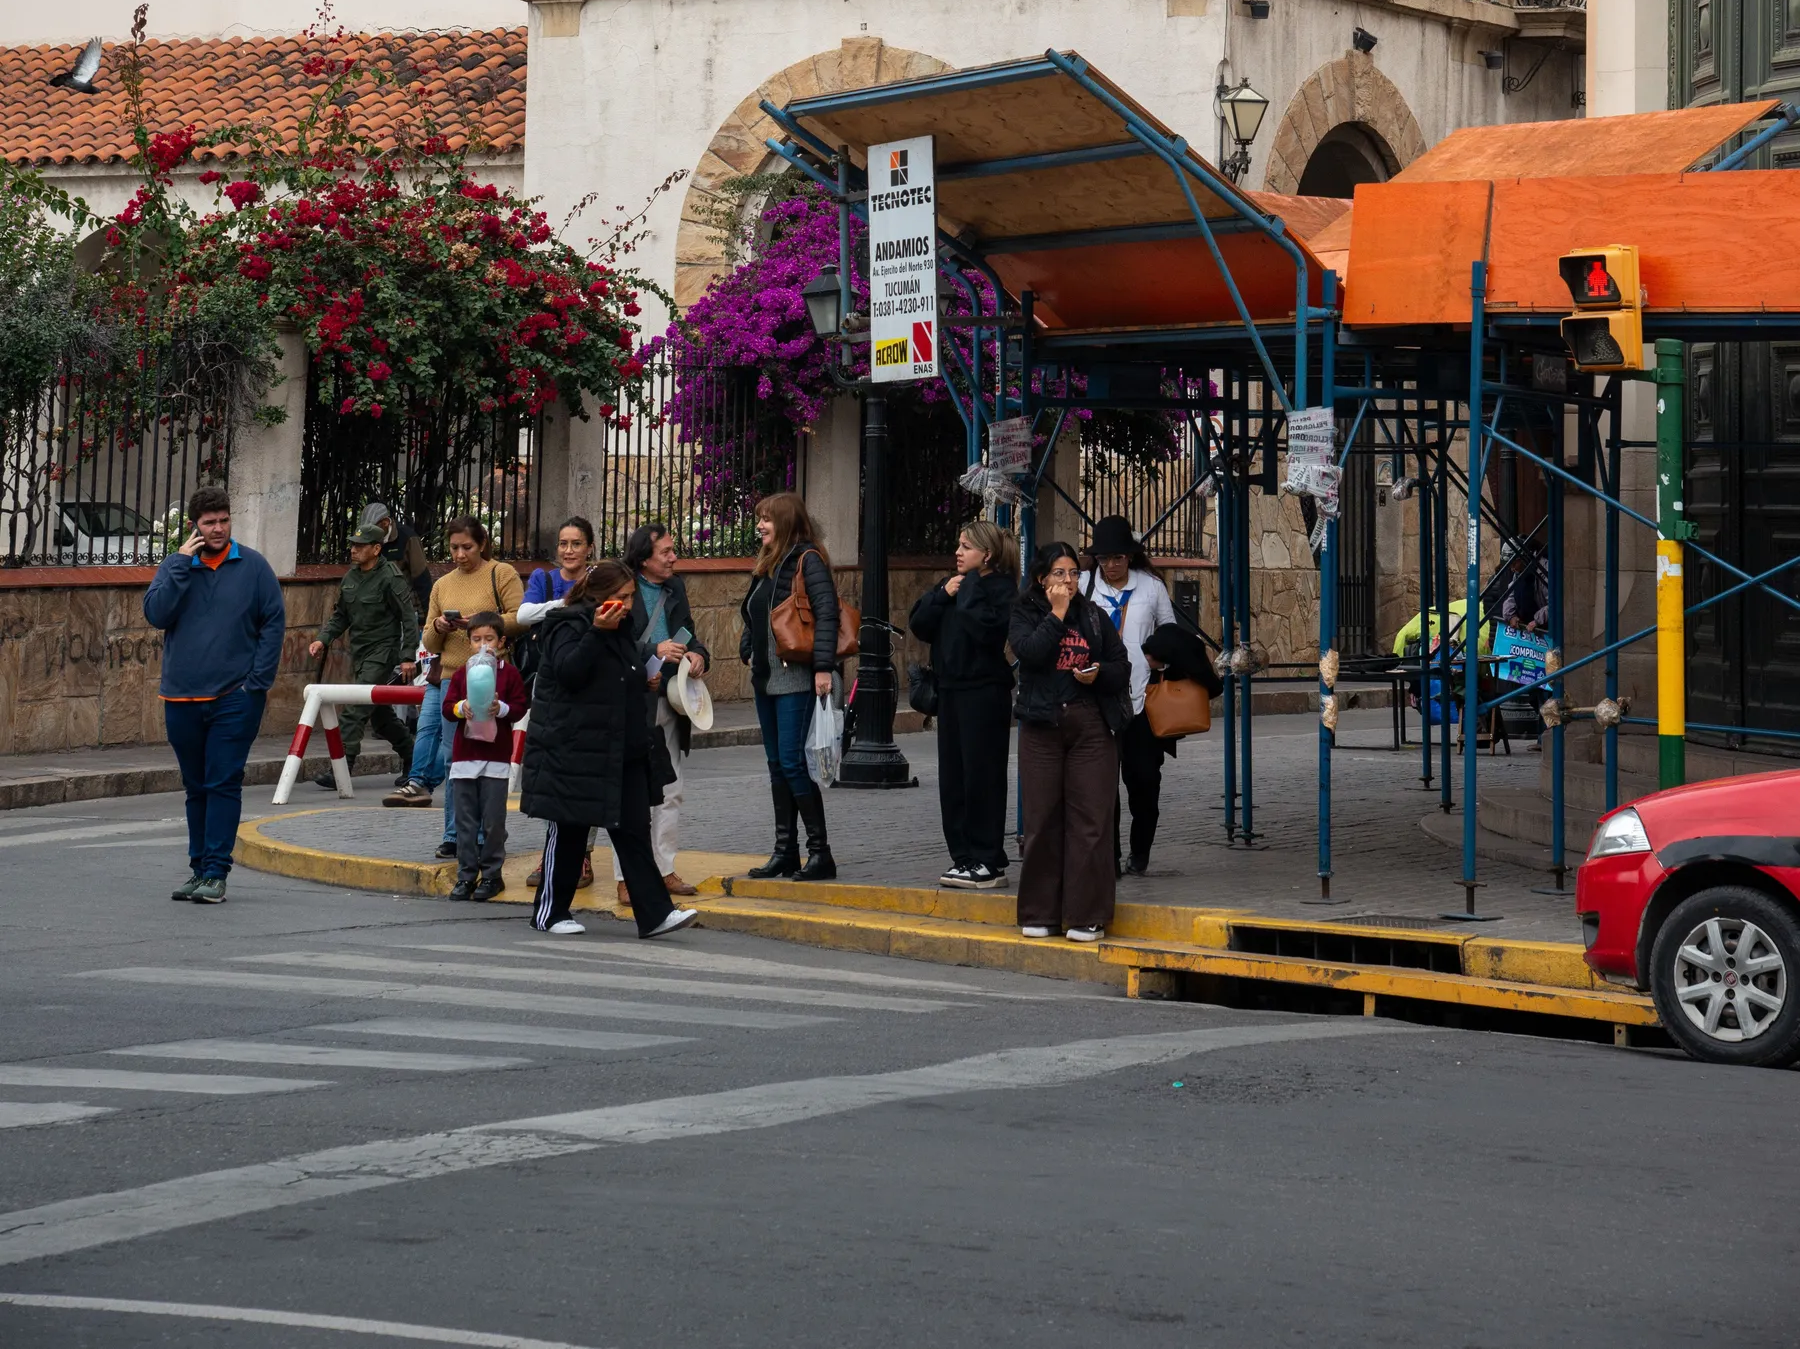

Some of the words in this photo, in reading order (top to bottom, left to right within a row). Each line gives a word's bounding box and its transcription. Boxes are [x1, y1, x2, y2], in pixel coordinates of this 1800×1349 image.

[870, 185, 932, 213] TECNOTEC
[875, 235, 930, 262] ANDAMIOS
[872, 266, 880, 277] Av.
[899, 262, 908, 273] del
[908, 262, 923, 272] Norte
[923, 259, 934, 270] 930
[885, 274, 920, 297] TUCUMÁN
[873, 295, 934, 318] T:0381-4230-911
[876, 339, 908, 366] ACROW
[913, 363, 933, 374] ENAS
